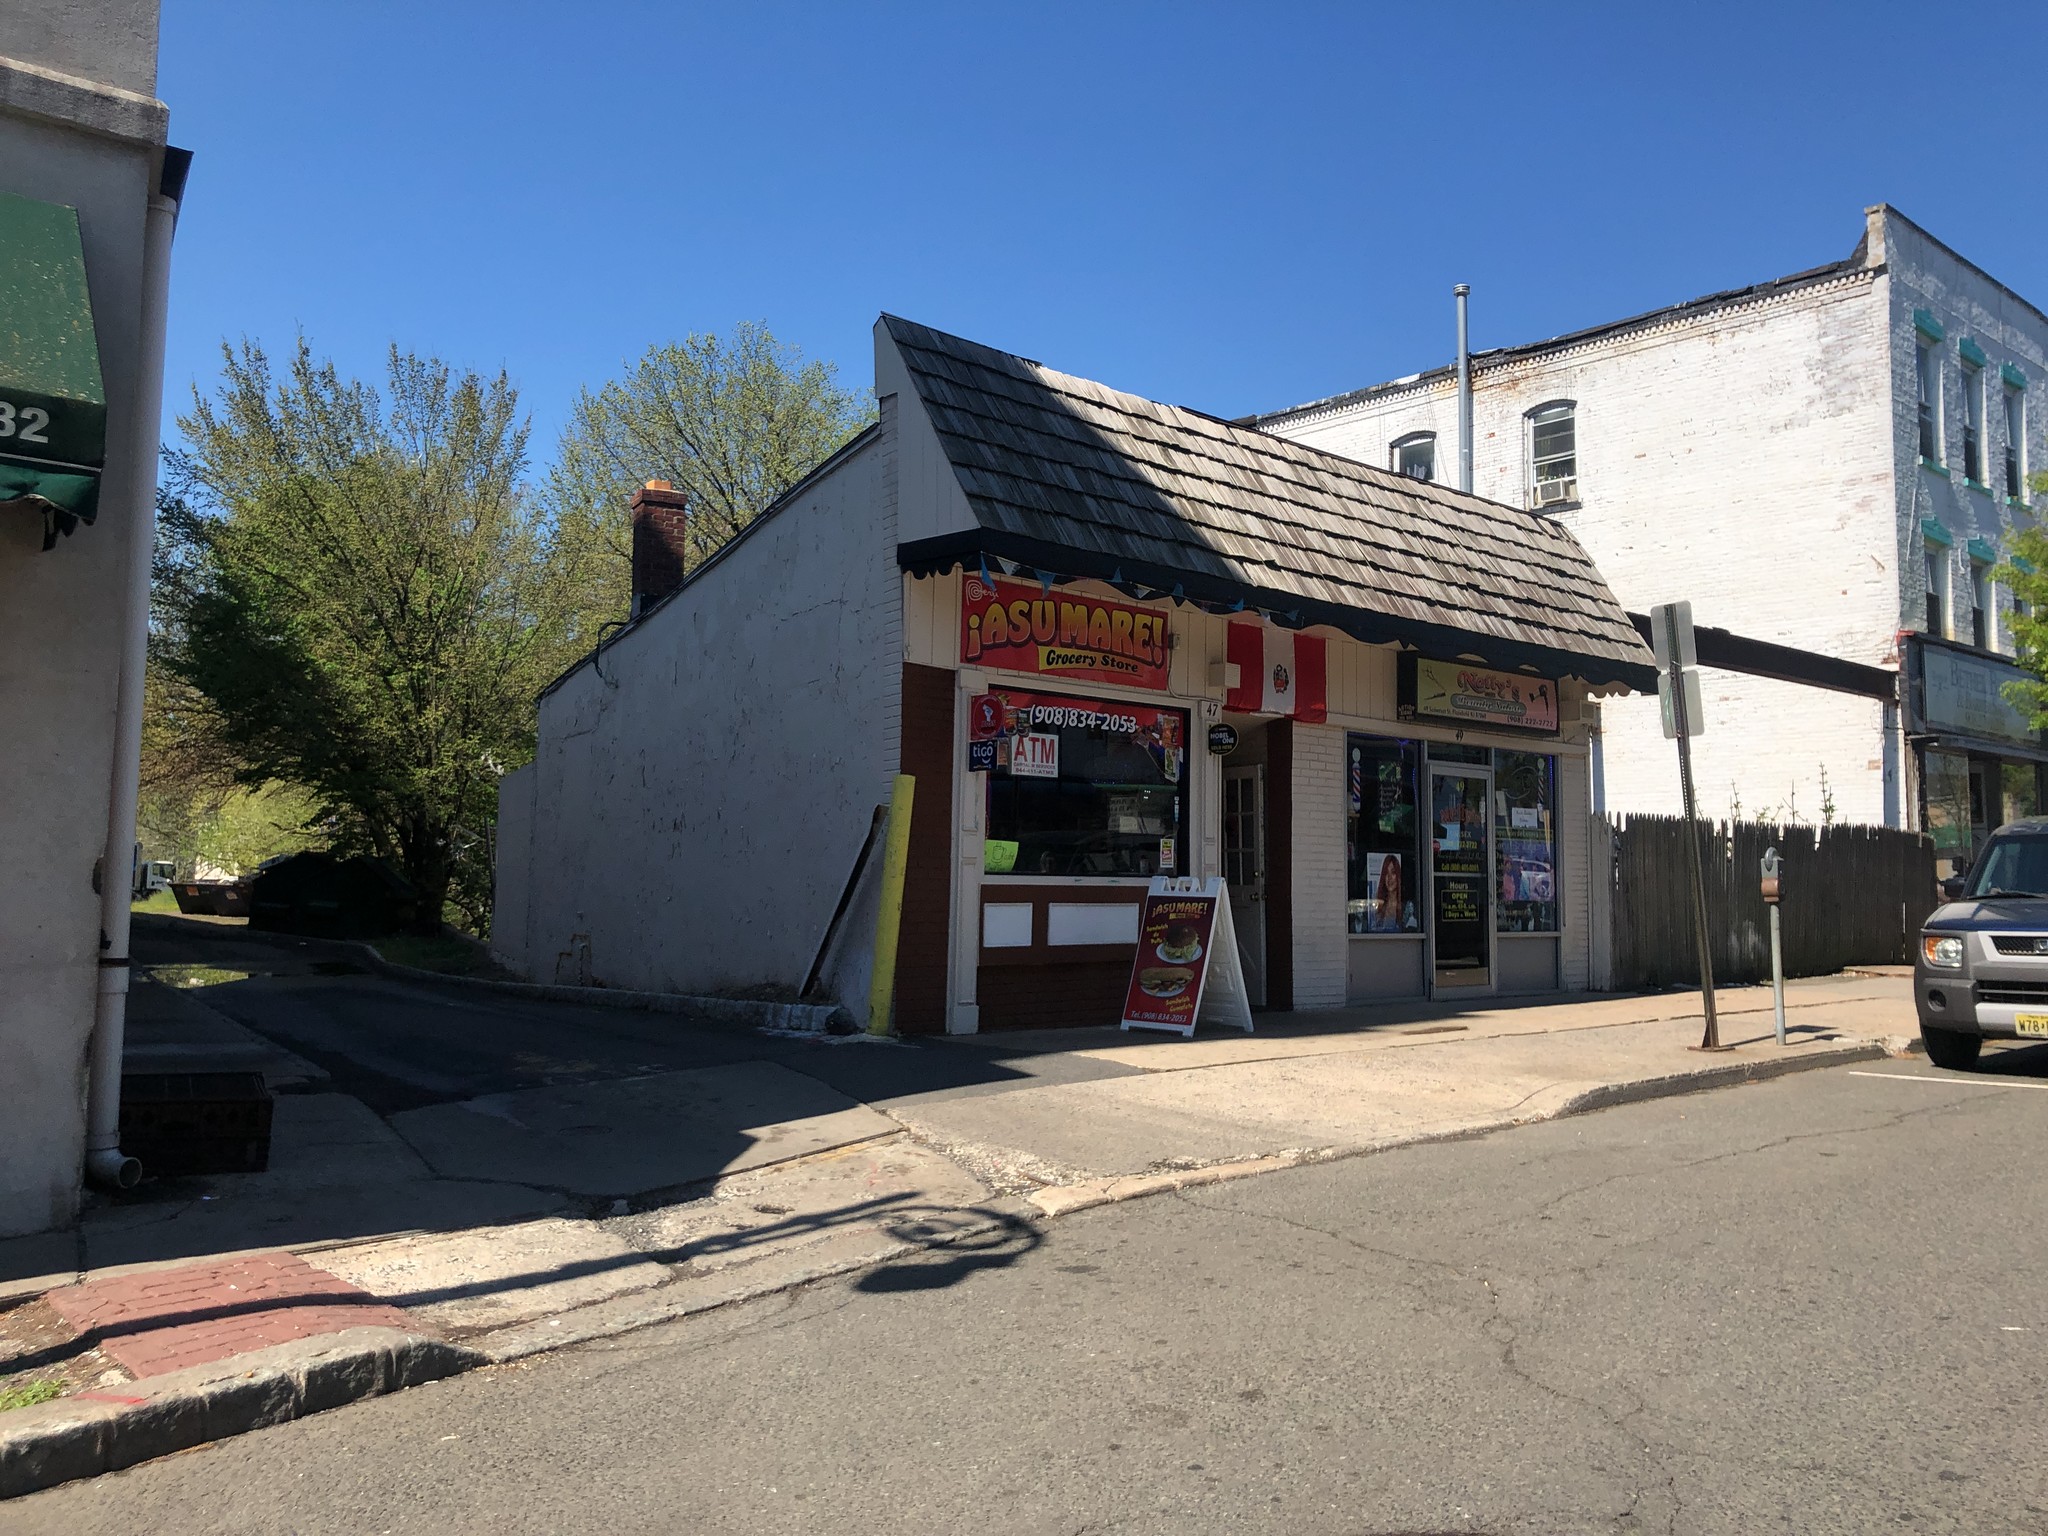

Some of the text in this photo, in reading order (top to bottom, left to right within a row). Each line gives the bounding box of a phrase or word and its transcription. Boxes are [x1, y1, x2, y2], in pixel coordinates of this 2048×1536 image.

[1046, 649, 1138, 673] Grocery Store
[1207, 702, 1218, 716] 47
[1029, 704, 1137, 733] (908)834-2053
[1455, 729, 1464, 742] 49
[1014, 735, 1055, 764] ATM
[1456, 780, 1465, 792] 49
[1449, 881, 1468, 890] Hours
[1158, 1013, 1187, 1022] 834-2053
